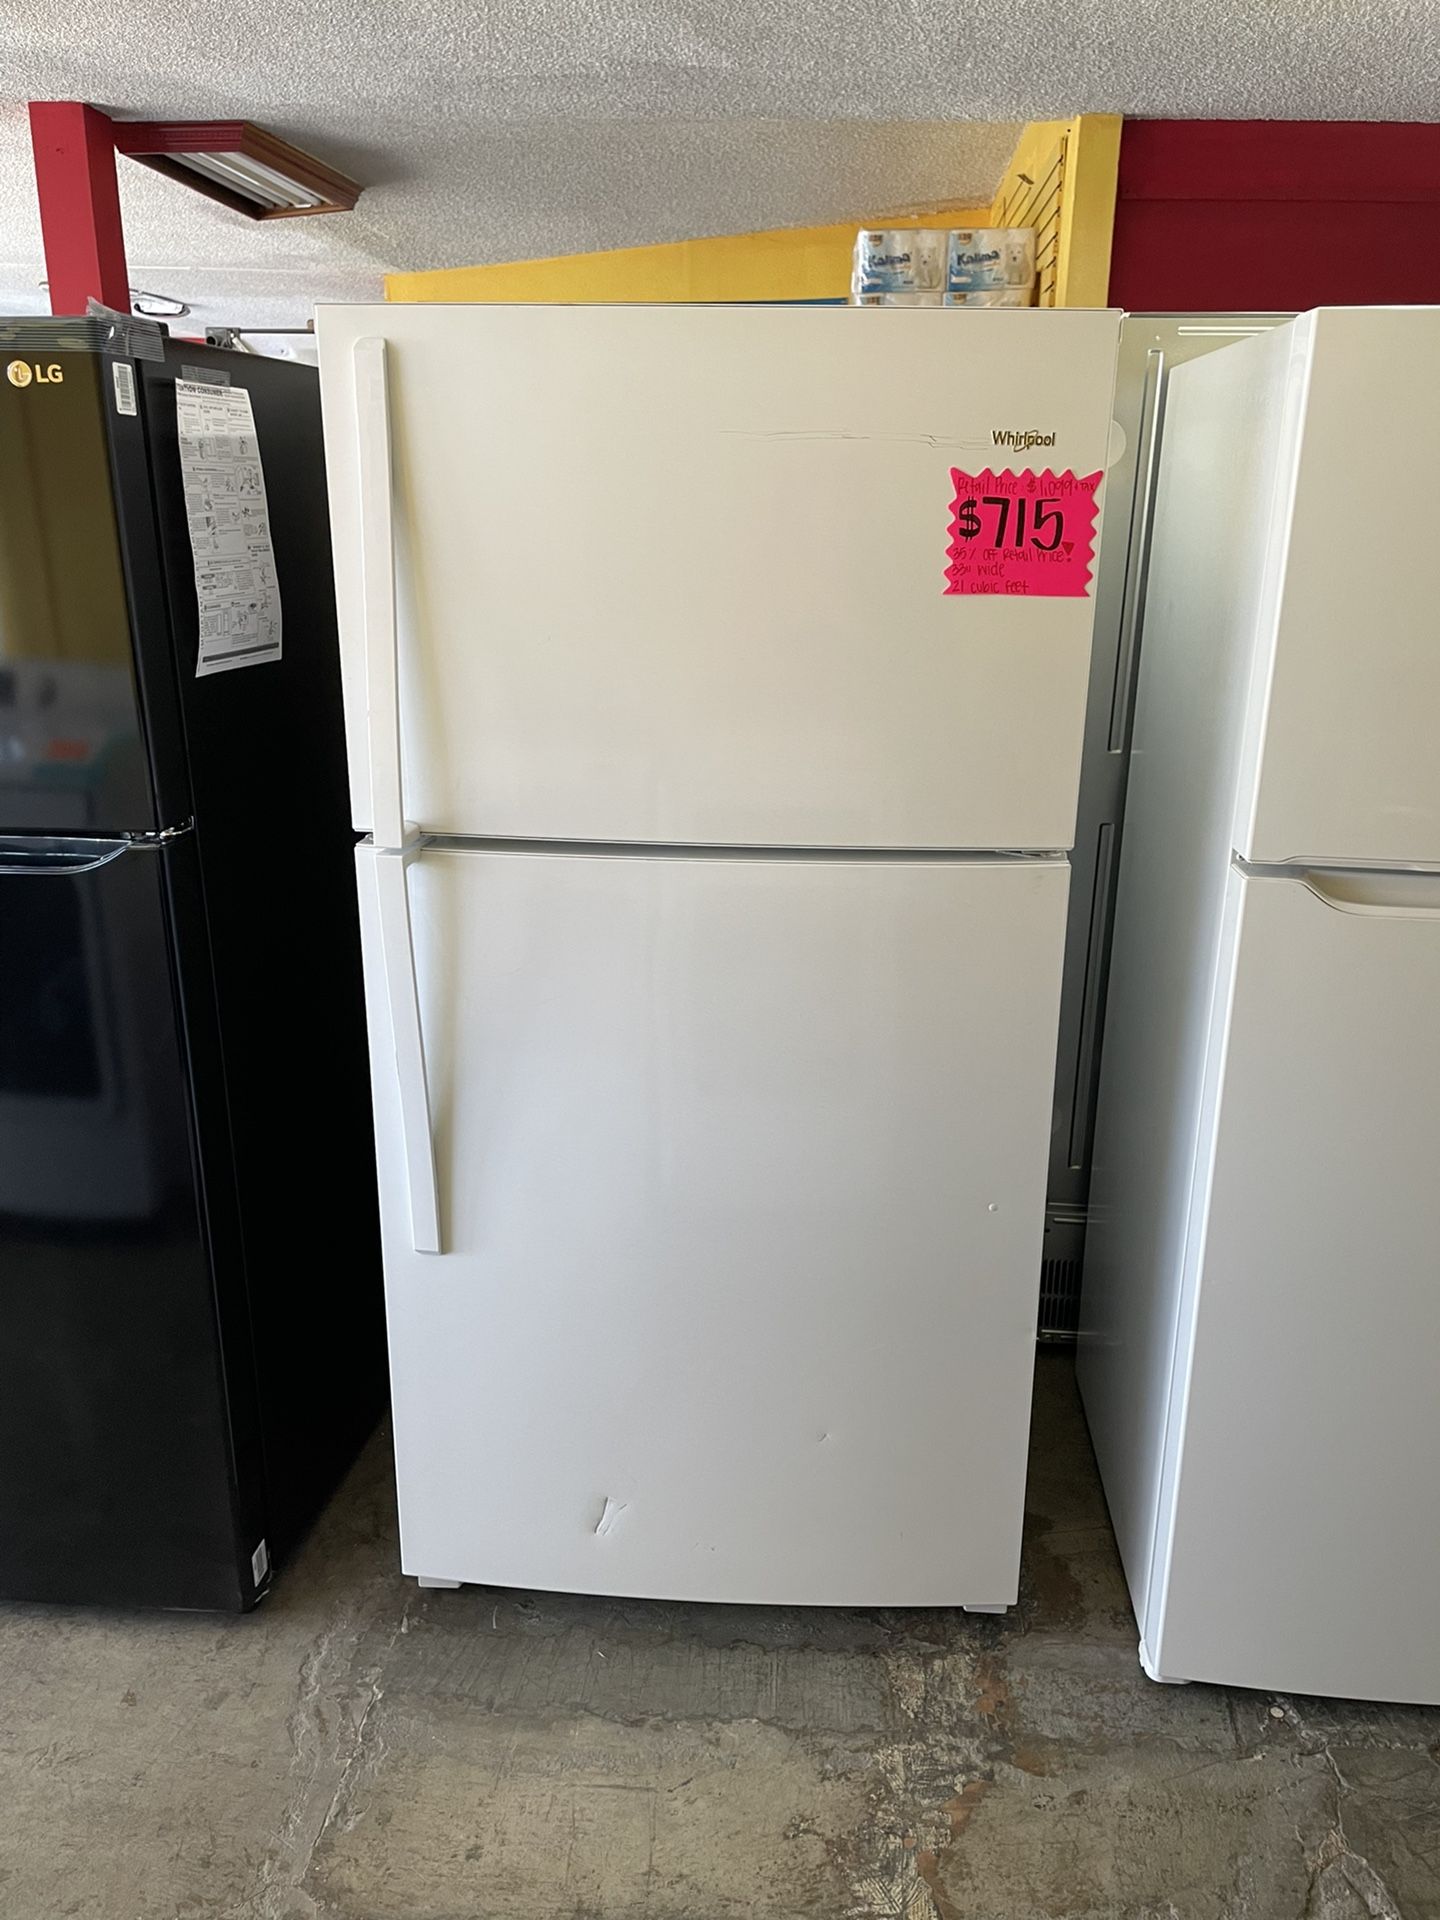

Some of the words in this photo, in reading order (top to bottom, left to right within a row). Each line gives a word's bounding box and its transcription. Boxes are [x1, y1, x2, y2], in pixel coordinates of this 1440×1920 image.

[868, 252, 911, 268] Kalima
[957, 249, 1000, 266] Kalima
[35, 363, 64, 384] LG
[992, 429, 1056, 451] Whirlpool
[957, 476, 990, 495] Retail
[994, 476, 1018, 495] Price
[958, 496, 1064, 551] $715
[1002, 546, 1032, 561] Retail
[952, 580, 965, 593] 21
[970, 580, 999, 594] cubic
